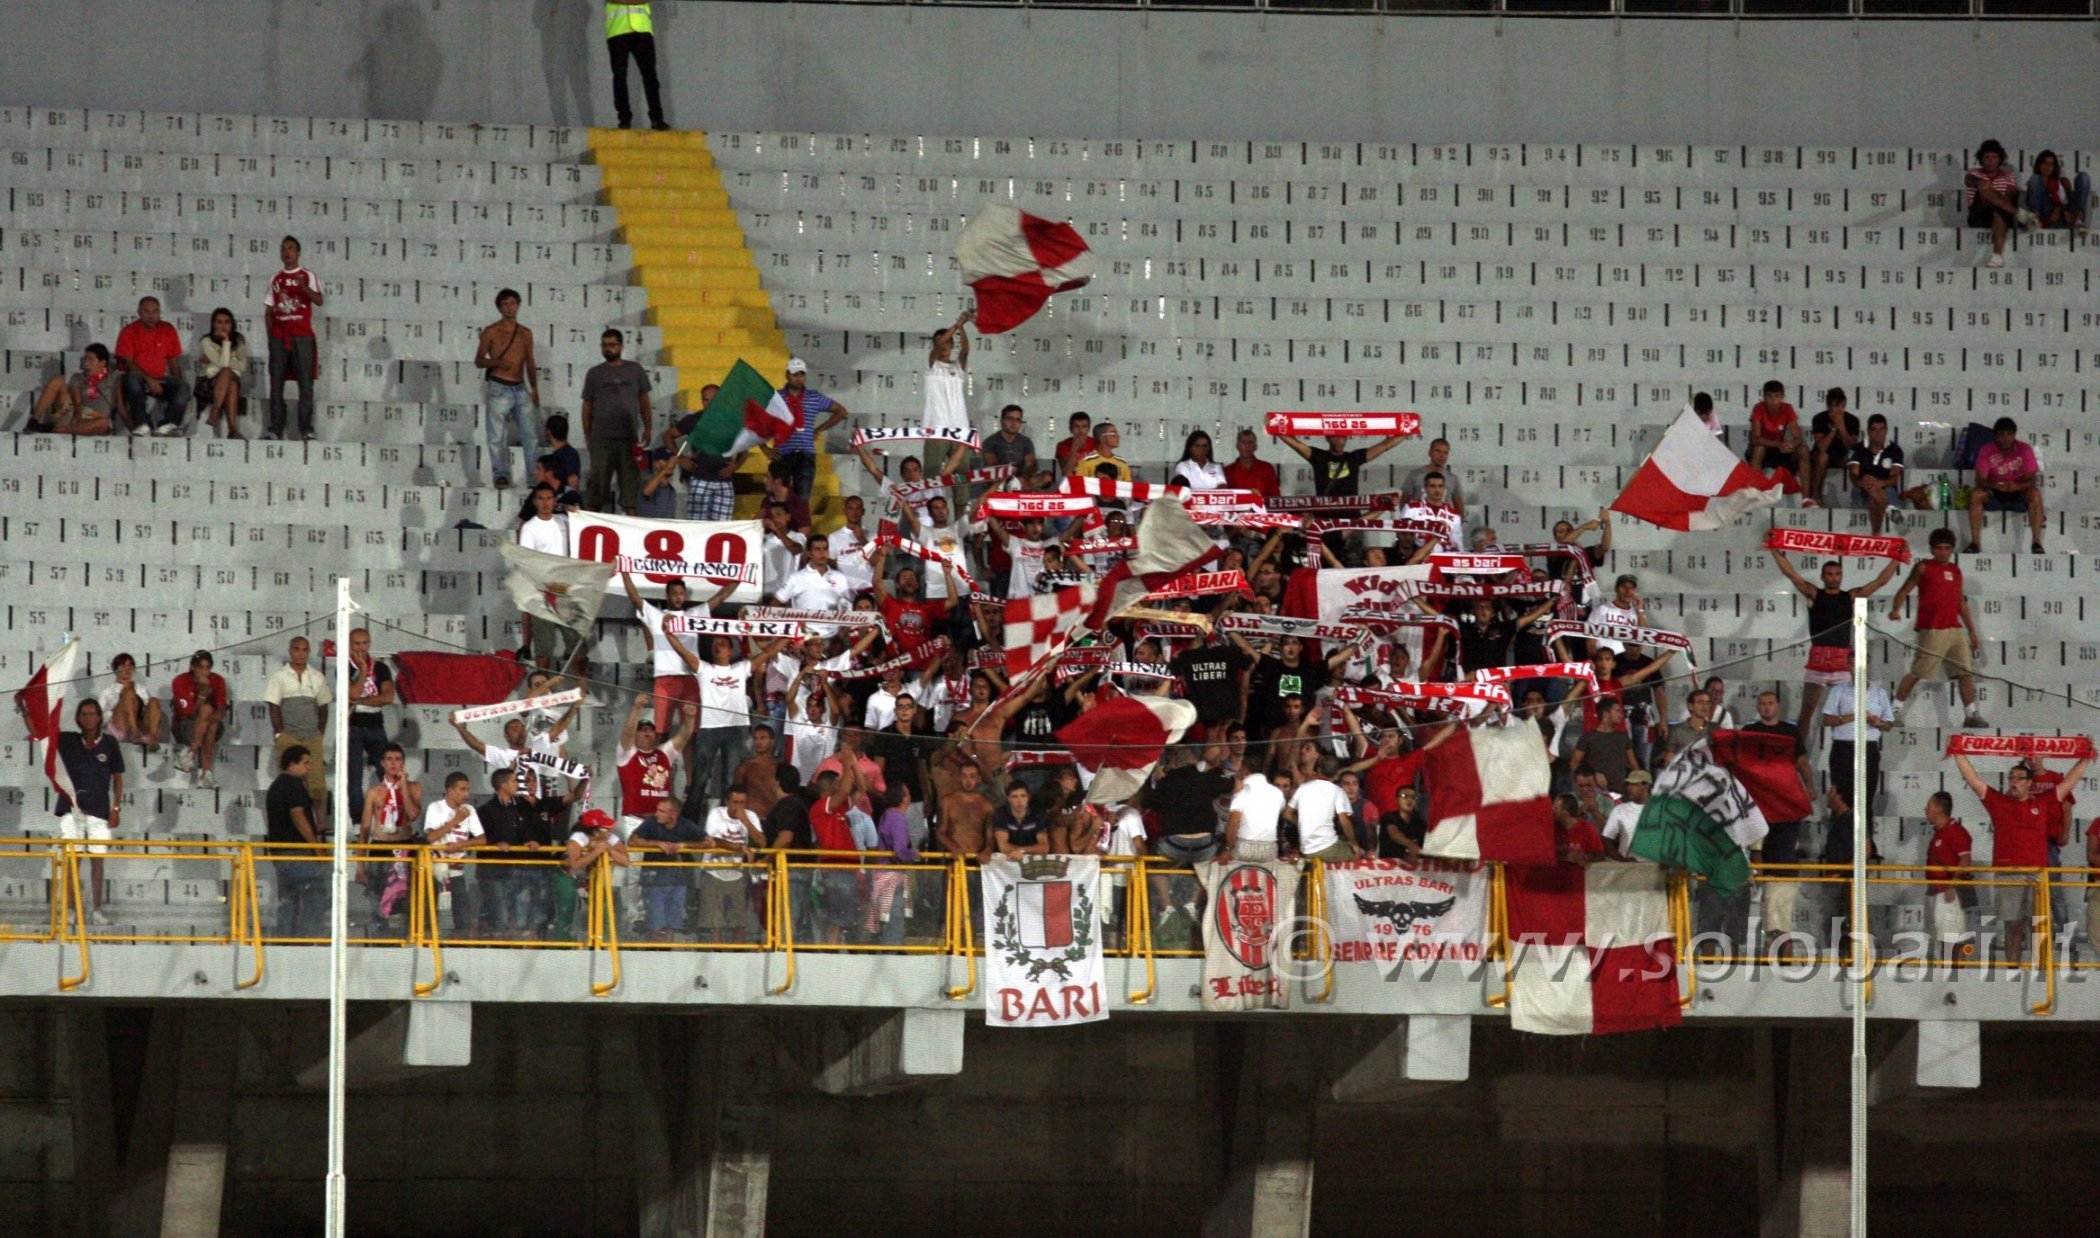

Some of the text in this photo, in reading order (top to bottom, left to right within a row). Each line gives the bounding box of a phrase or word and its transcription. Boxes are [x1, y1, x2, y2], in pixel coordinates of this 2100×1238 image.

[1209, 493, 1237, 505] bari
[1784, 532, 1889, 554] FORZA BARI
[1451, 556, 1501, 568] as bari
[1198, 572, 1235, 588] BARI
[1418, 581, 1484, 596] CLAN
[1221, 615, 1360, 640] ULT RAS
[1583, 623, 1659, 645] MBR
[1192, 662, 1228, 673] ULTRAS
[1193, 671, 1227, 681] LIBERI
[1963, 736, 2076, 754] FORZA BARI
[1355, 875, 1456, 894] ULTRAS BARI
[1374, 924, 1432, 936] 19 76
[997, 981, 1101, 1022] BARI
